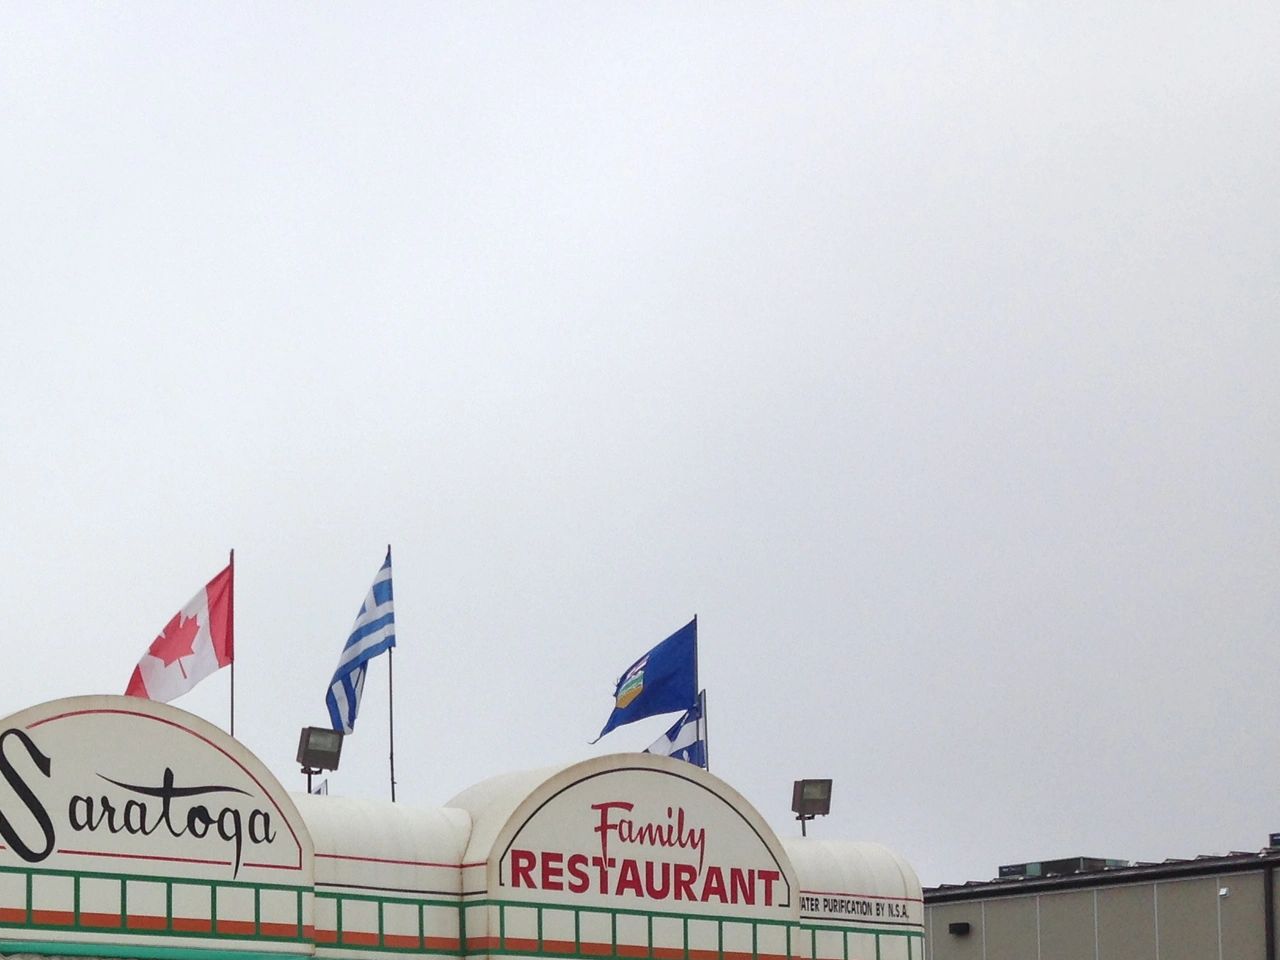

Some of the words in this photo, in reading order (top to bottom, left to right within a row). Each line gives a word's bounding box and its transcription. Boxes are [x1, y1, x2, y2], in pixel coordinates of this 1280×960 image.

[591, 801, 705, 877] Family
[511, 849, 780, 907] RESTAURANT
[800, 897, 820, 912] ATER
[823, 898, 873, 916] PURIFICATION
[876, 903, 886, 916] BY
[888, 903, 910, 918] N.S.A.
